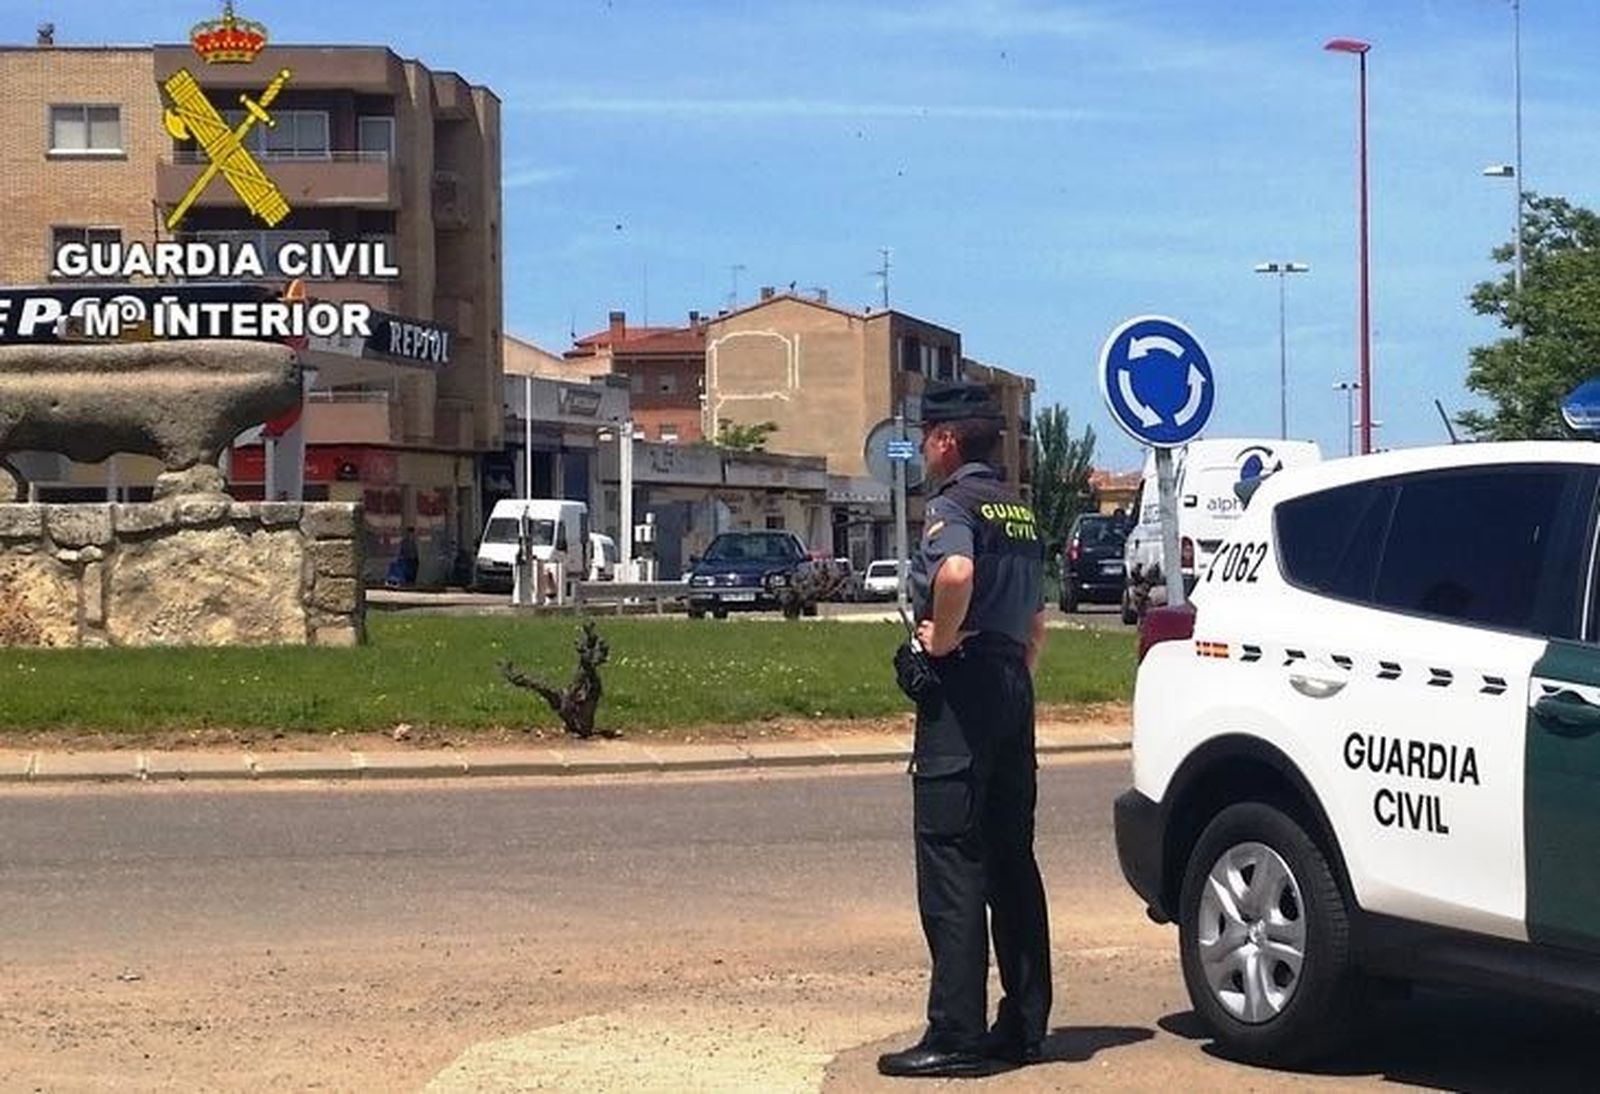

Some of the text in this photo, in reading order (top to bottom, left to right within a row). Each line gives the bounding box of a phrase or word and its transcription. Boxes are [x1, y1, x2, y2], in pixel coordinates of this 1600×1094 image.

[389, 320, 448, 363] REPSOL
[1005, 521, 1038, 541] CIVIL
[1343, 732, 1480, 786] GUARDIA
[1373, 788, 1449, 835] CIVIL
